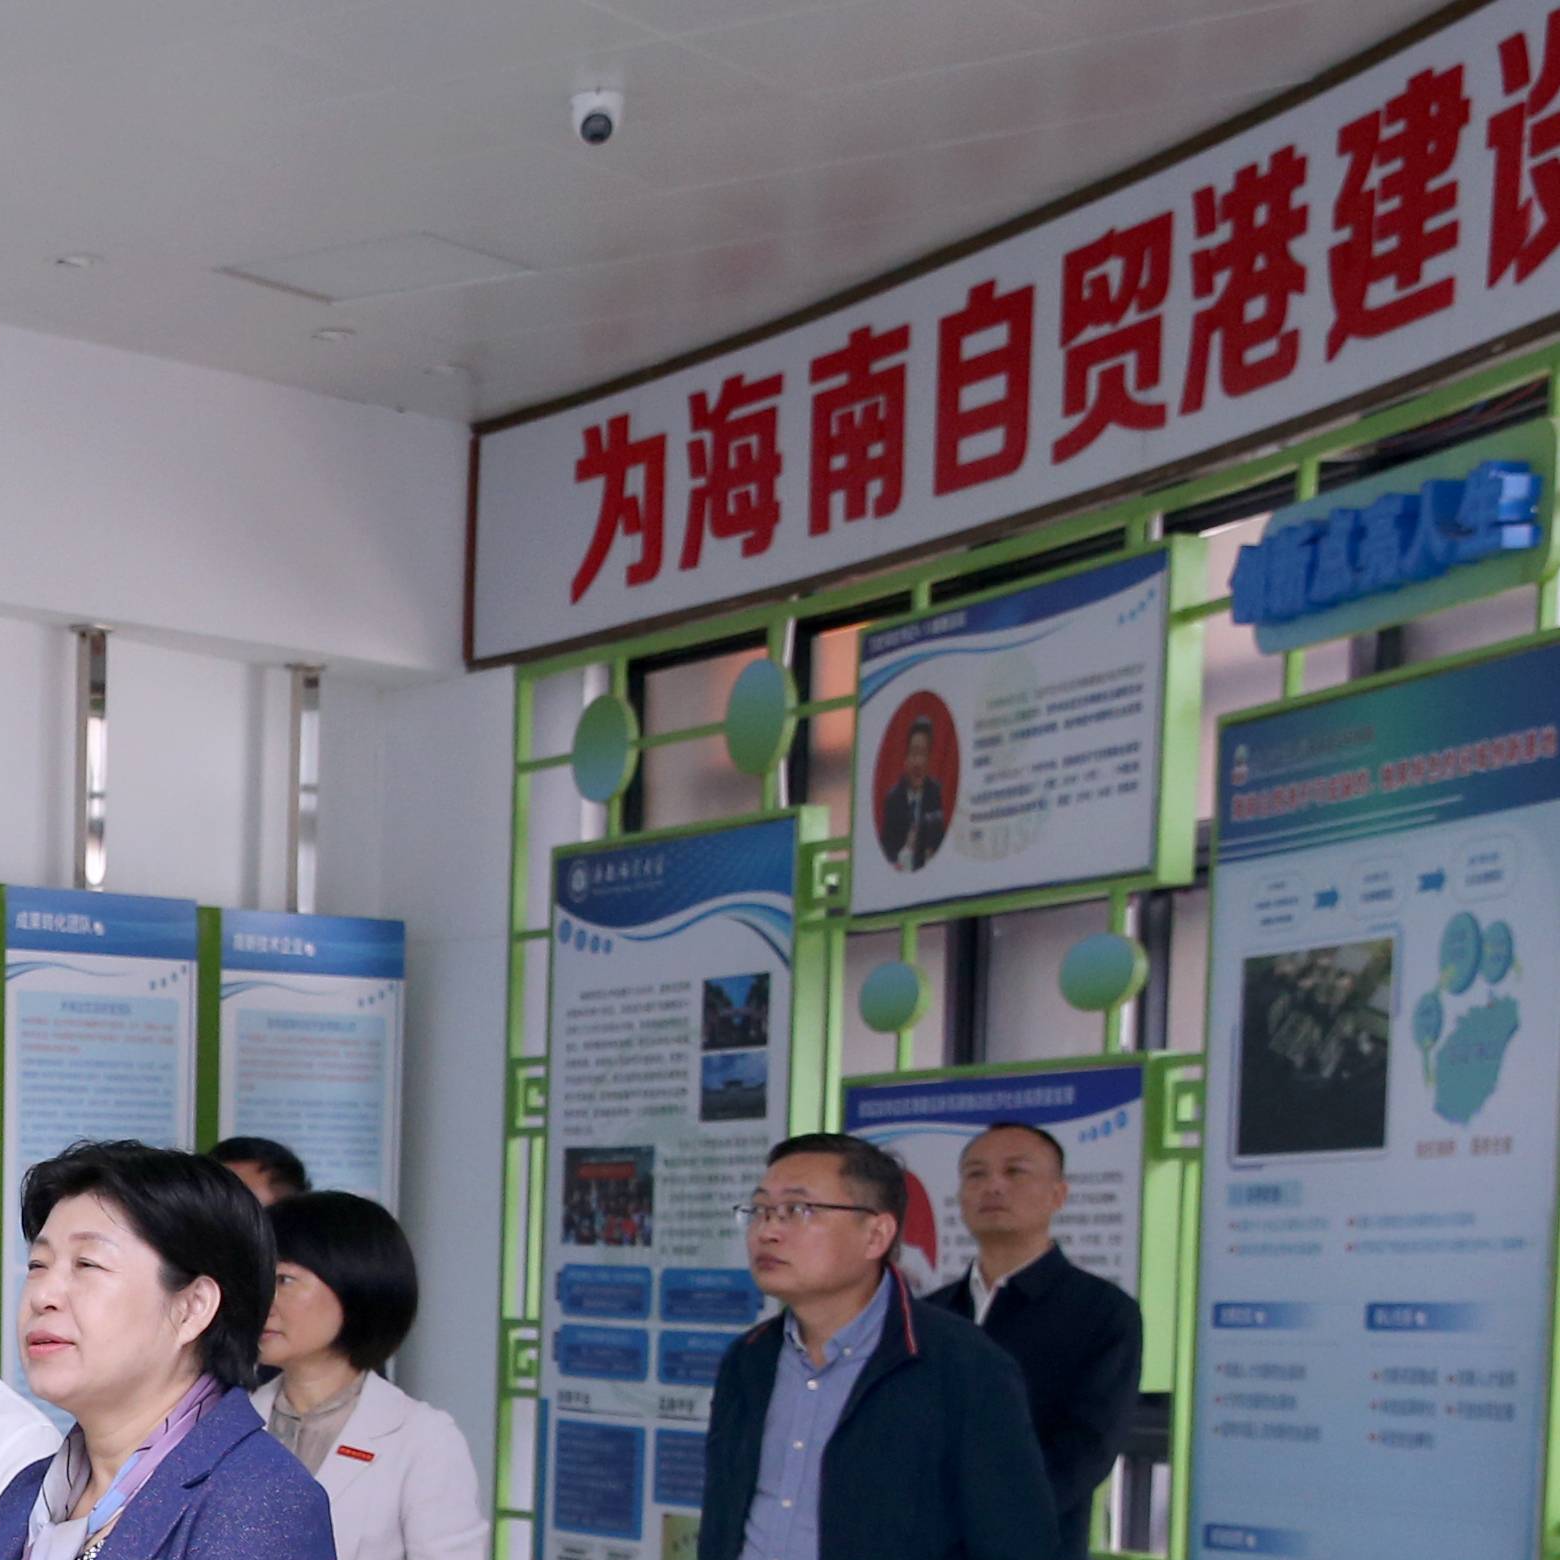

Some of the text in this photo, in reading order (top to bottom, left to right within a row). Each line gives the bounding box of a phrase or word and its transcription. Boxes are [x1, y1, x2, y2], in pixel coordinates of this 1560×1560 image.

[571, 8, 1560, 604] 为海南自贸港建设
